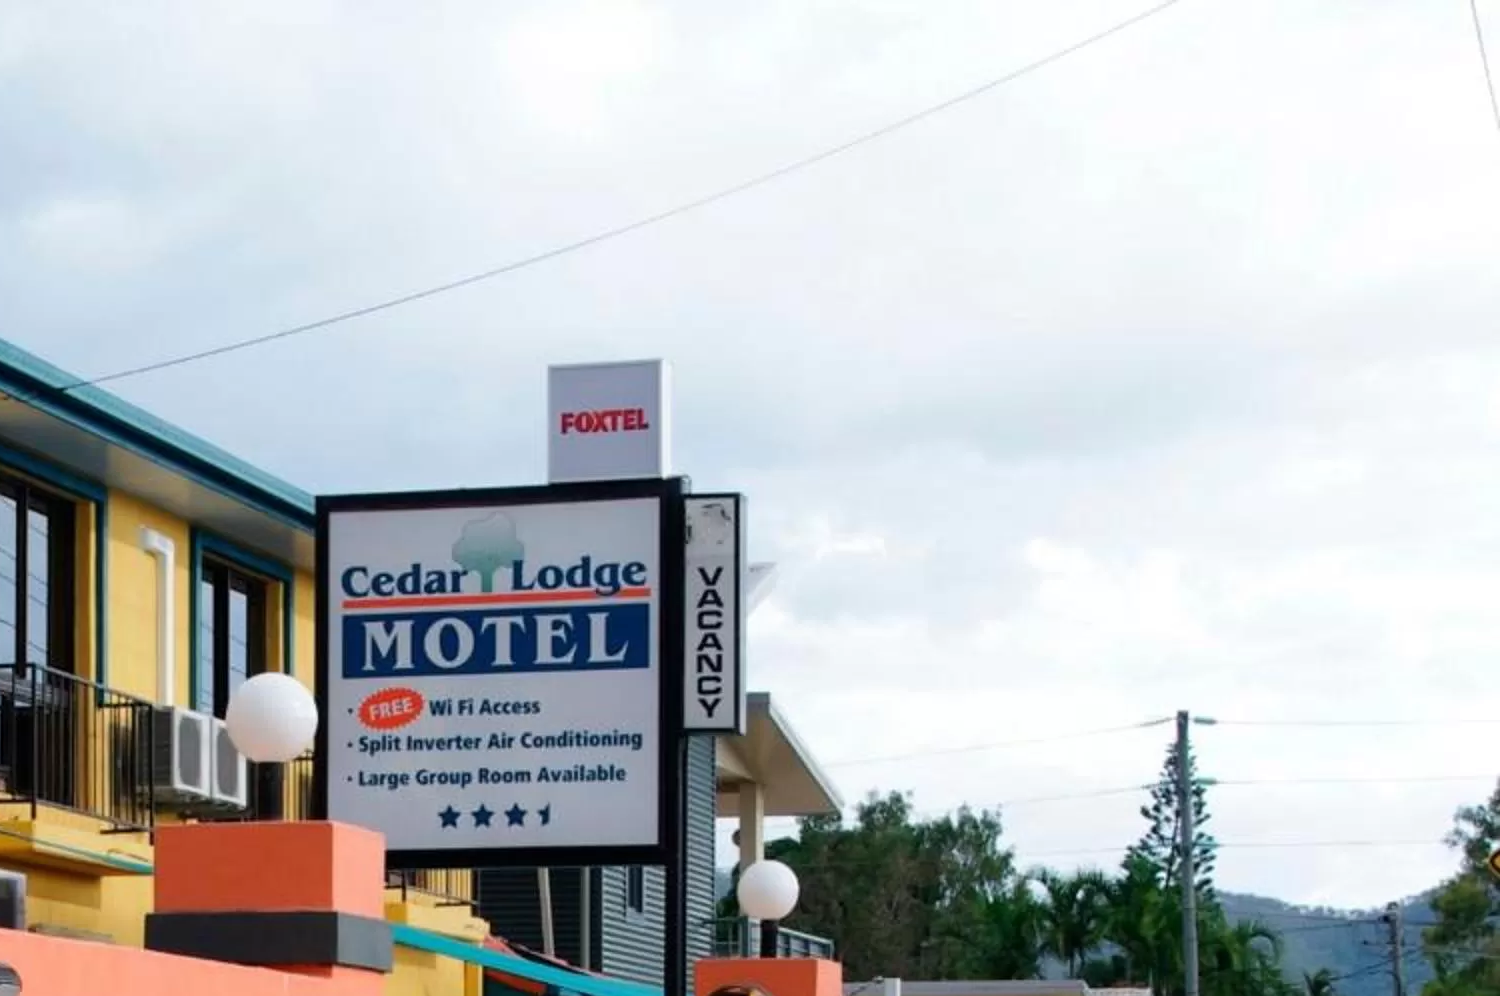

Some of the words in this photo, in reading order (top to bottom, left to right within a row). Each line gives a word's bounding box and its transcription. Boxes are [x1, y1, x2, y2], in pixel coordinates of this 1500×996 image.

[560, 408, 649, 435] FOXTEL
[341, 562, 468, 598] Cedar
[511, 555, 647, 597] Lodge
[361, 611, 630, 672] MOTEL
[696, 566, 724, 718] VACANCY
[369, 697, 414, 721] FREE
[429, 699, 452, 716] Wi
[458, 699, 474, 716] Fi
[479, 698, 541, 716] Access
[358, 735, 401, 757] Split
[406, 734, 482, 752] Inverter
[487, 732, 514, 750] Air
[520, 729, 643, 752] Conditioning
[358, 770, 410, 790] Large
[415, 768, 472, 790] Group
[478, 766, 531, 784] Room
[537, 763, 626, 783] Available
